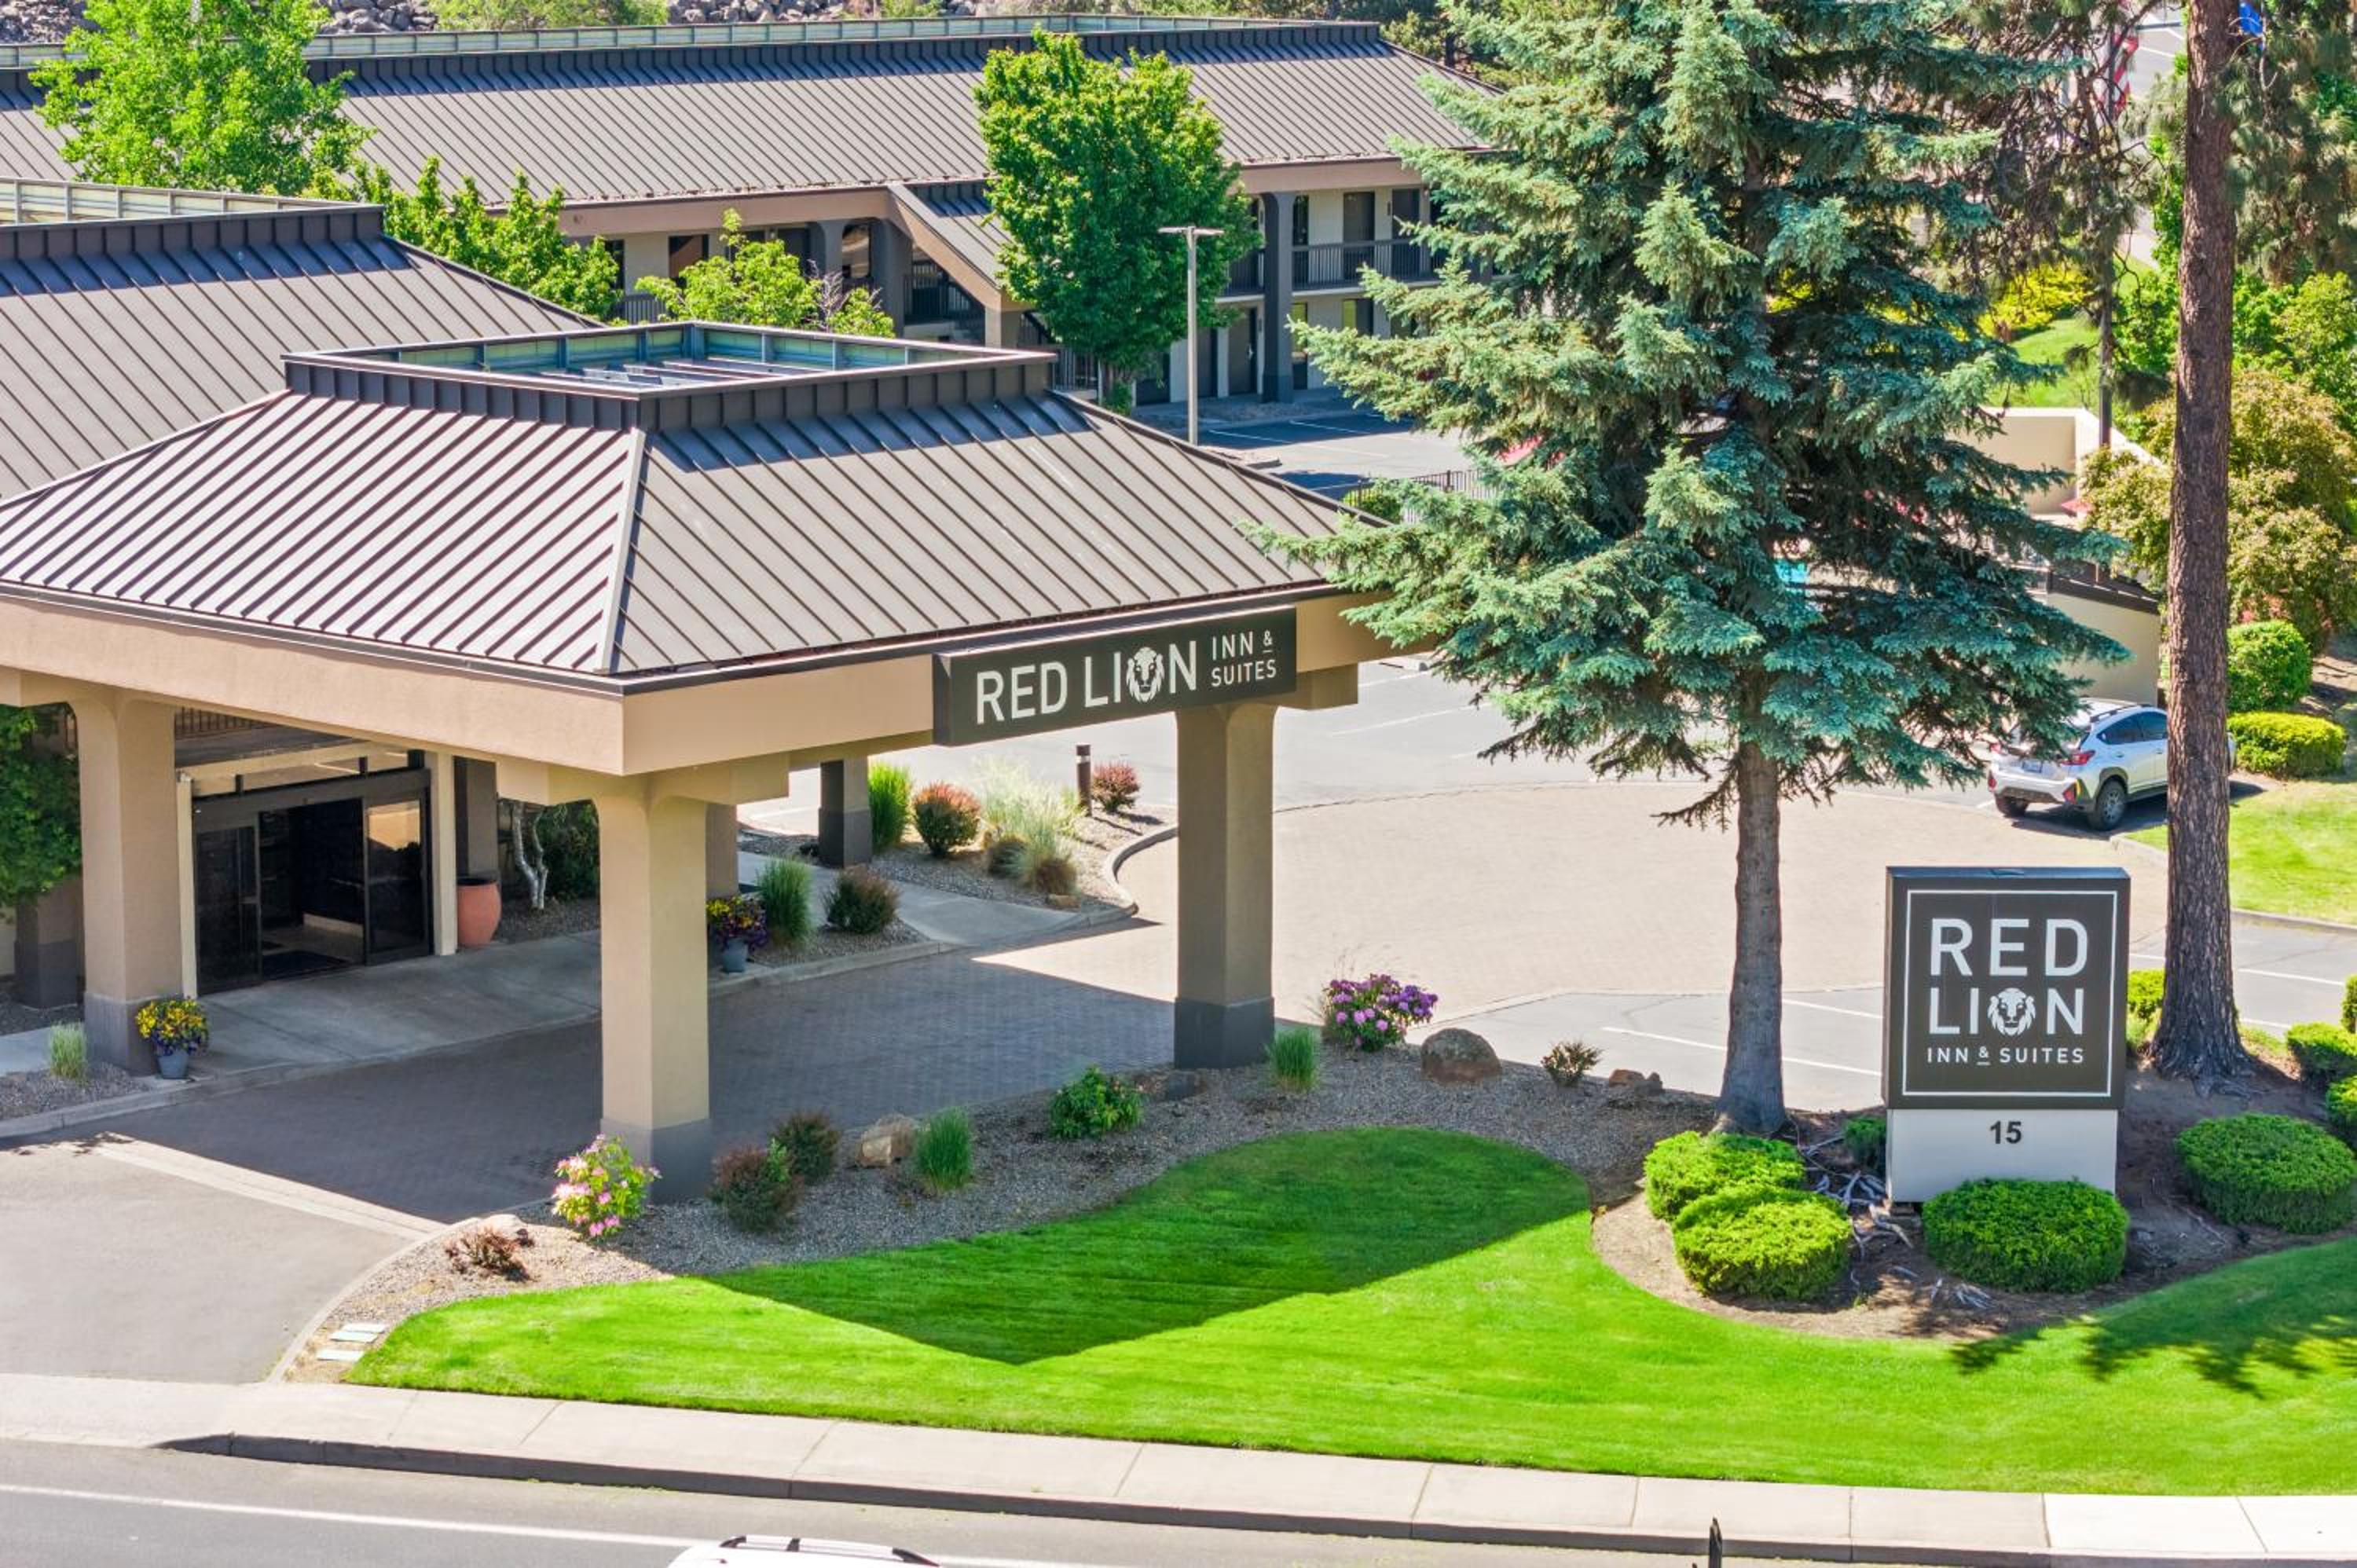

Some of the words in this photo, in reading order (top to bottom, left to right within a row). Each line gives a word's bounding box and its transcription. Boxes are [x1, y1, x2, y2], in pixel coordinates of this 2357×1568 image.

[1211, 632, 1254, 660] INN
[1262, 630, 1273, 654] &
[1211, 659, 1277, 687] SUITES
[977, 661, 1068, 724] RED
[1930, 918, 2088, 976] RED
[1927, 1048, 1968, 1063] INN
[1977, 1046, 1991, 1065] &
[2000, 1048, 2084, 1063] SUITES
[1990, 1121, 2022, 1145] 15
